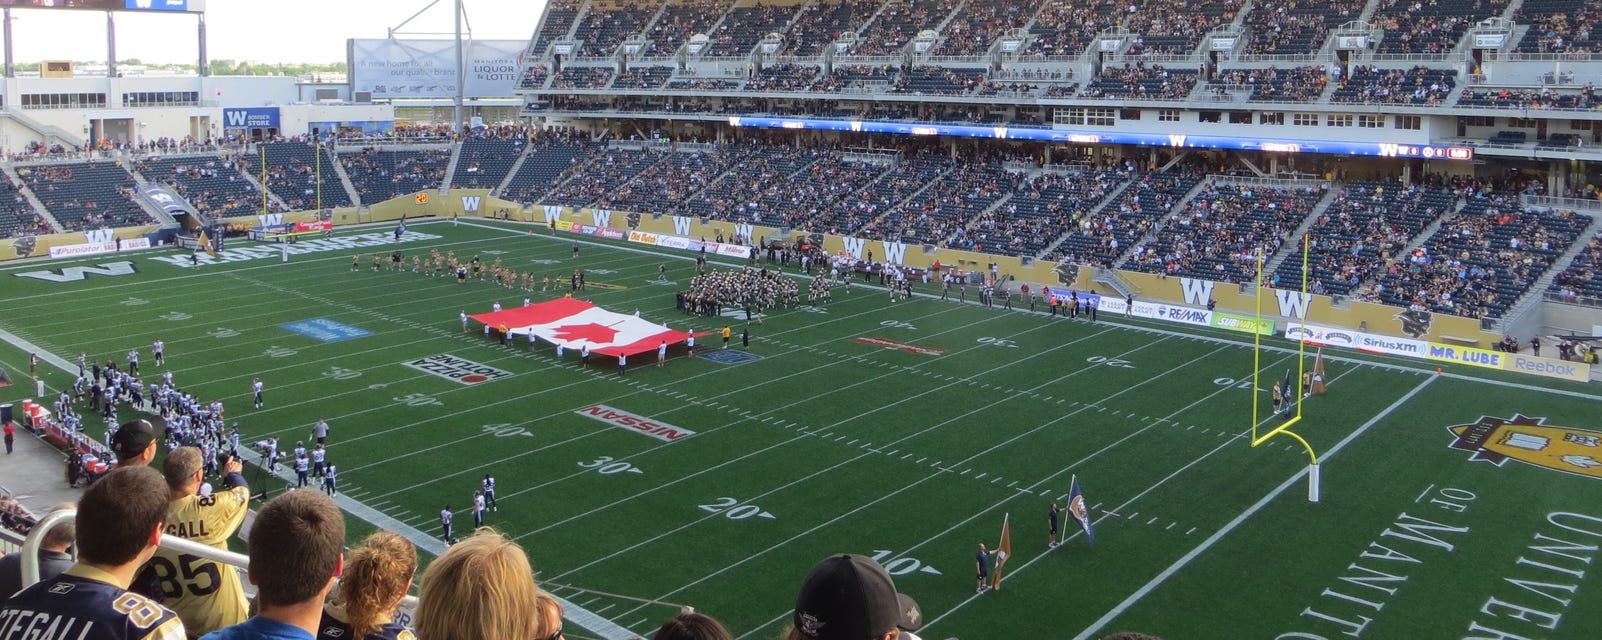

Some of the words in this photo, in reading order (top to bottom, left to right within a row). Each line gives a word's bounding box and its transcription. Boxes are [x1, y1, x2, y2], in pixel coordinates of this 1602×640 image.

[386, 59, 407, 67] home
[475, 65, 514, 73] LIQUOR
[226, 111, 247, 125] W
[1379, 143, 1399, 157] W
[462, 196, 481, 212] W
[543, 205, 563, 223] W
[592, 209, 611, 228] W
[672, 216, 692, 236] W
[61, 246, 100, 254] Purolator
[842, 236, 866, 262] W
[882, 241, 907, 266] W
[1180, 277, 1214, 306] W
[1275, 289, 1313, 320] W
[1168, 308, 1209, 323] RE/MAX
[1217, 316, 1258, 330] SUBWAY
[1429, 345, 1459, 360] MR.
[1462, 351, 1500, 366] LUBE
[410, 359, 471, 379] PIZZA
[427, 354, 511, 378] HOTLINE
[1514, 357, 1576, 377] Reebok
[580, 406, 689, 441] NISSAN
[577, 456, 632, 474] 30
[697, 497, 760, 520] 20
[1430, 488, 1477, 512] OF
[166, 519, 209, 538] GALL
[148, 553, 222, 599] 85
[112, 591, 163, 629] 8
